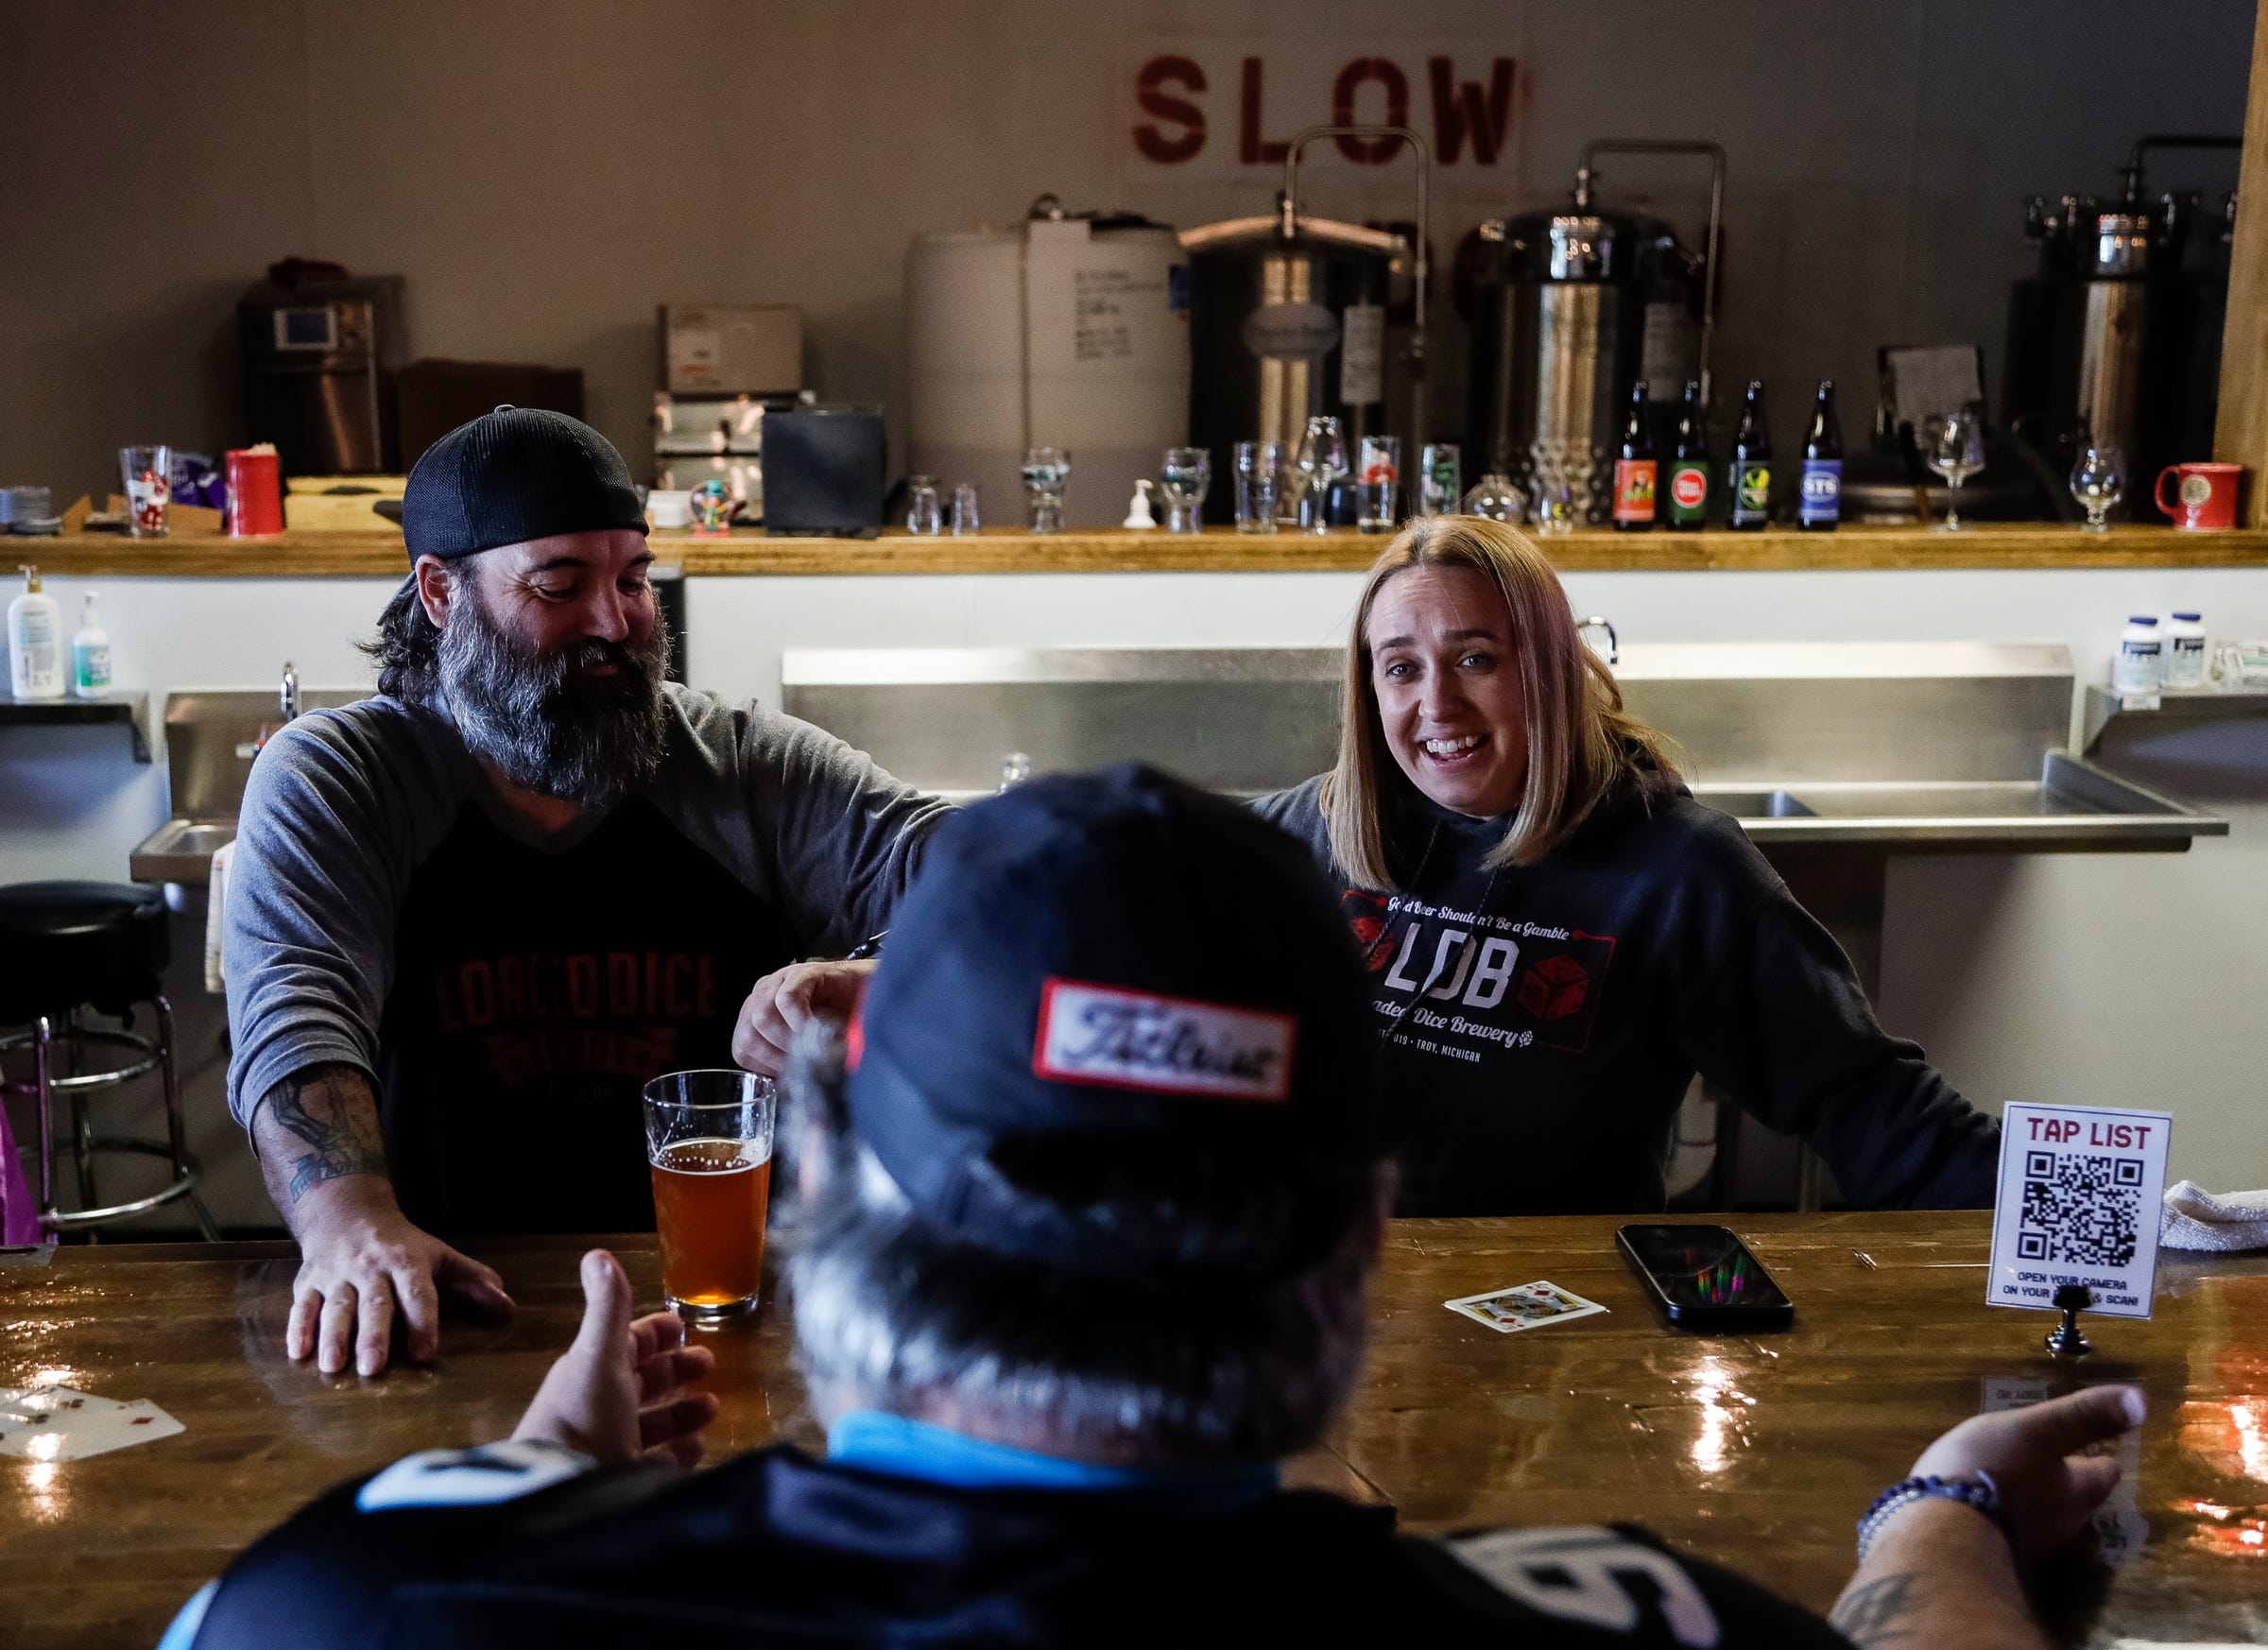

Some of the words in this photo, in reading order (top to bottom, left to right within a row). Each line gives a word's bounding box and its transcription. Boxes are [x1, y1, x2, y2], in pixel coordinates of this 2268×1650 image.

[1133, 54, 1517, 167] SLOW
[1387, 896, 1414, 913] God
[1415, 901, 1437, 917] Beer
[1496, 917, 1512, 931] Be
[1512, 922, 1522, 933] a
[1522, 921, 1570, 940] Gamble
[1384, 921, 1520, 1009] LDB
[435, 954, 598, 1033] LOAD
[1372, 1000, 1407, 1018] ade
[1414, 1007, 1448, 1028] Dice
[1451, 1016, 1519, 1048] Brewery
[1392, 1034, 1408, 1045] 019
[1417, 1040, 1438, 1054] TROY,
[1441, 1044, 1481, 1063] MICHIGAN
[2027, 1117, 2081, 1143] TAP
[2089, 1123, 2152, 1150] LIST
[2002, 1284, 2019, 1295] ON
[2021, 1287, 2050, 1298] YOUR
[2093, 1293, 2103, 1304] &
[2105, 1294, 2139, 1307] SCAN!
[2017, 1271, 2047, 1283] OPEN
[2051, 1274, 2079, 1286] YOUR
[2081, 1277, 2127, 1291] CAMERA
